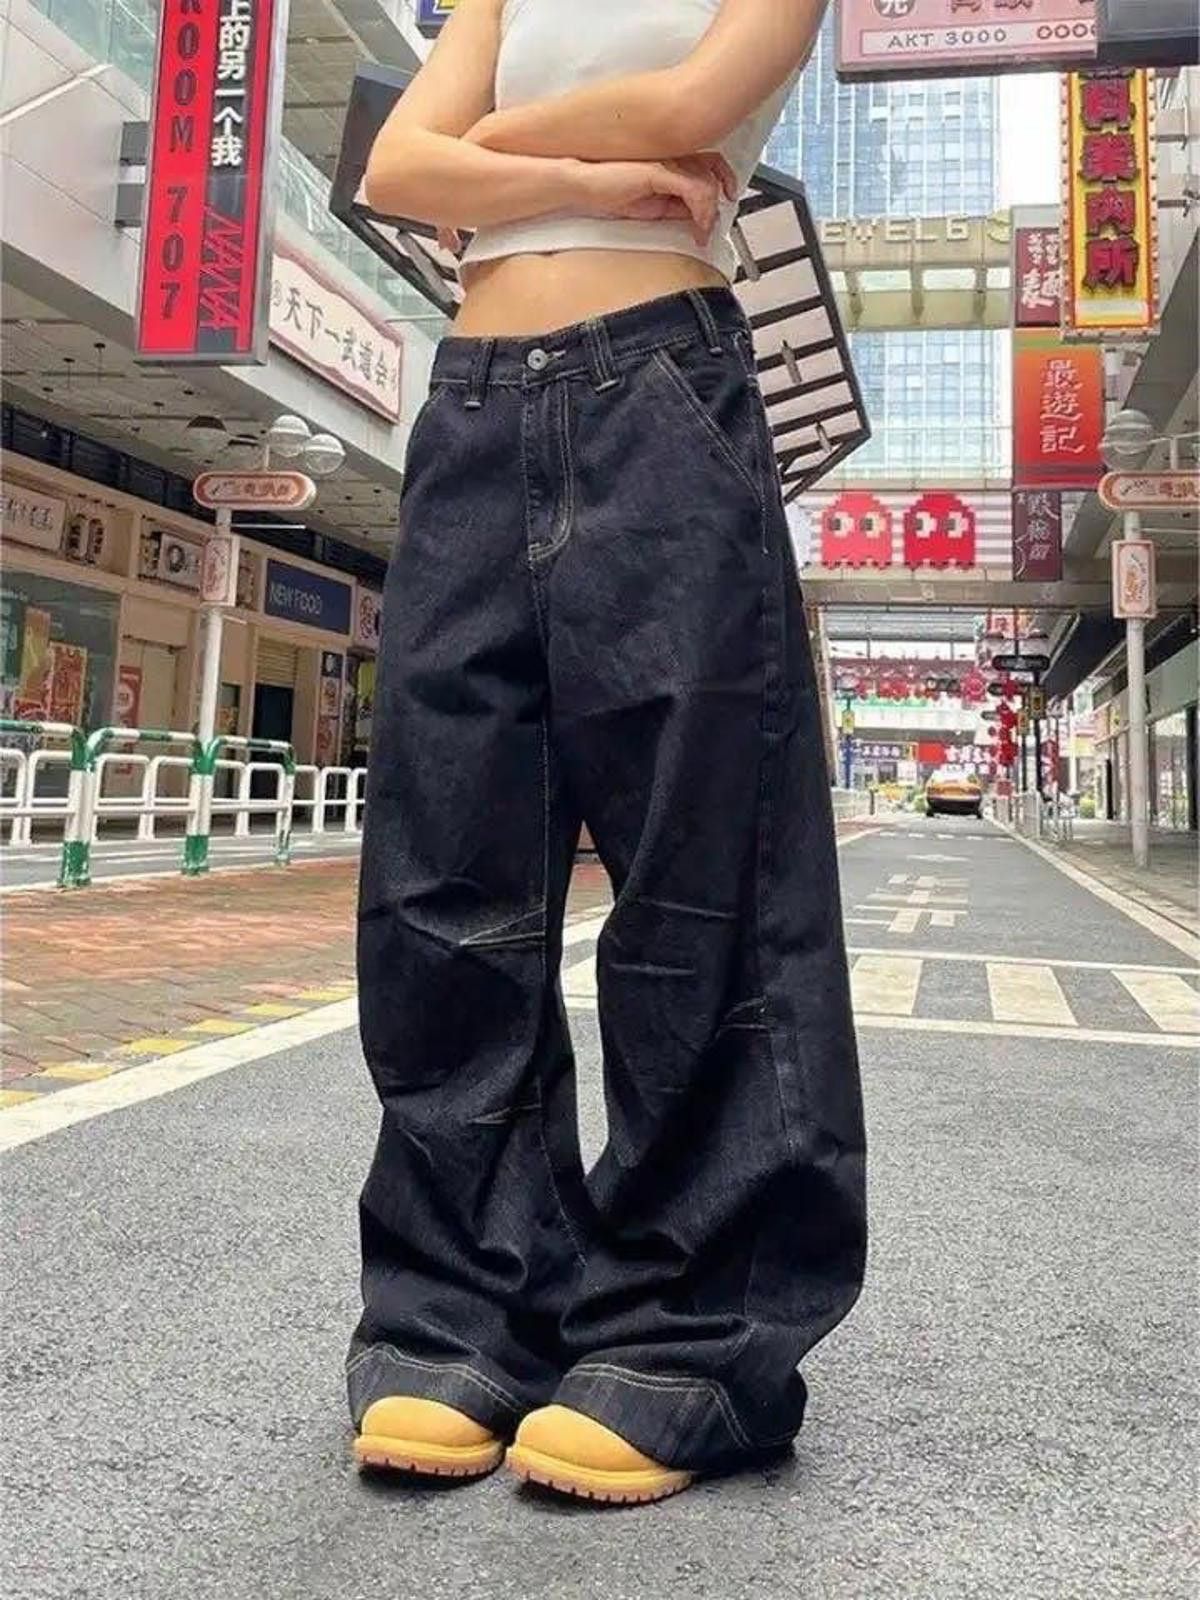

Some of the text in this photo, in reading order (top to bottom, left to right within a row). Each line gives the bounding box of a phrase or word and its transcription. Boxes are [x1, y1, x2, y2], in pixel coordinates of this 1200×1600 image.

[888, 29, 1007, 49] AKT 3000
[160, 186, 188, 320] 707
[1040, 359, 1086, 454] 最遊記
